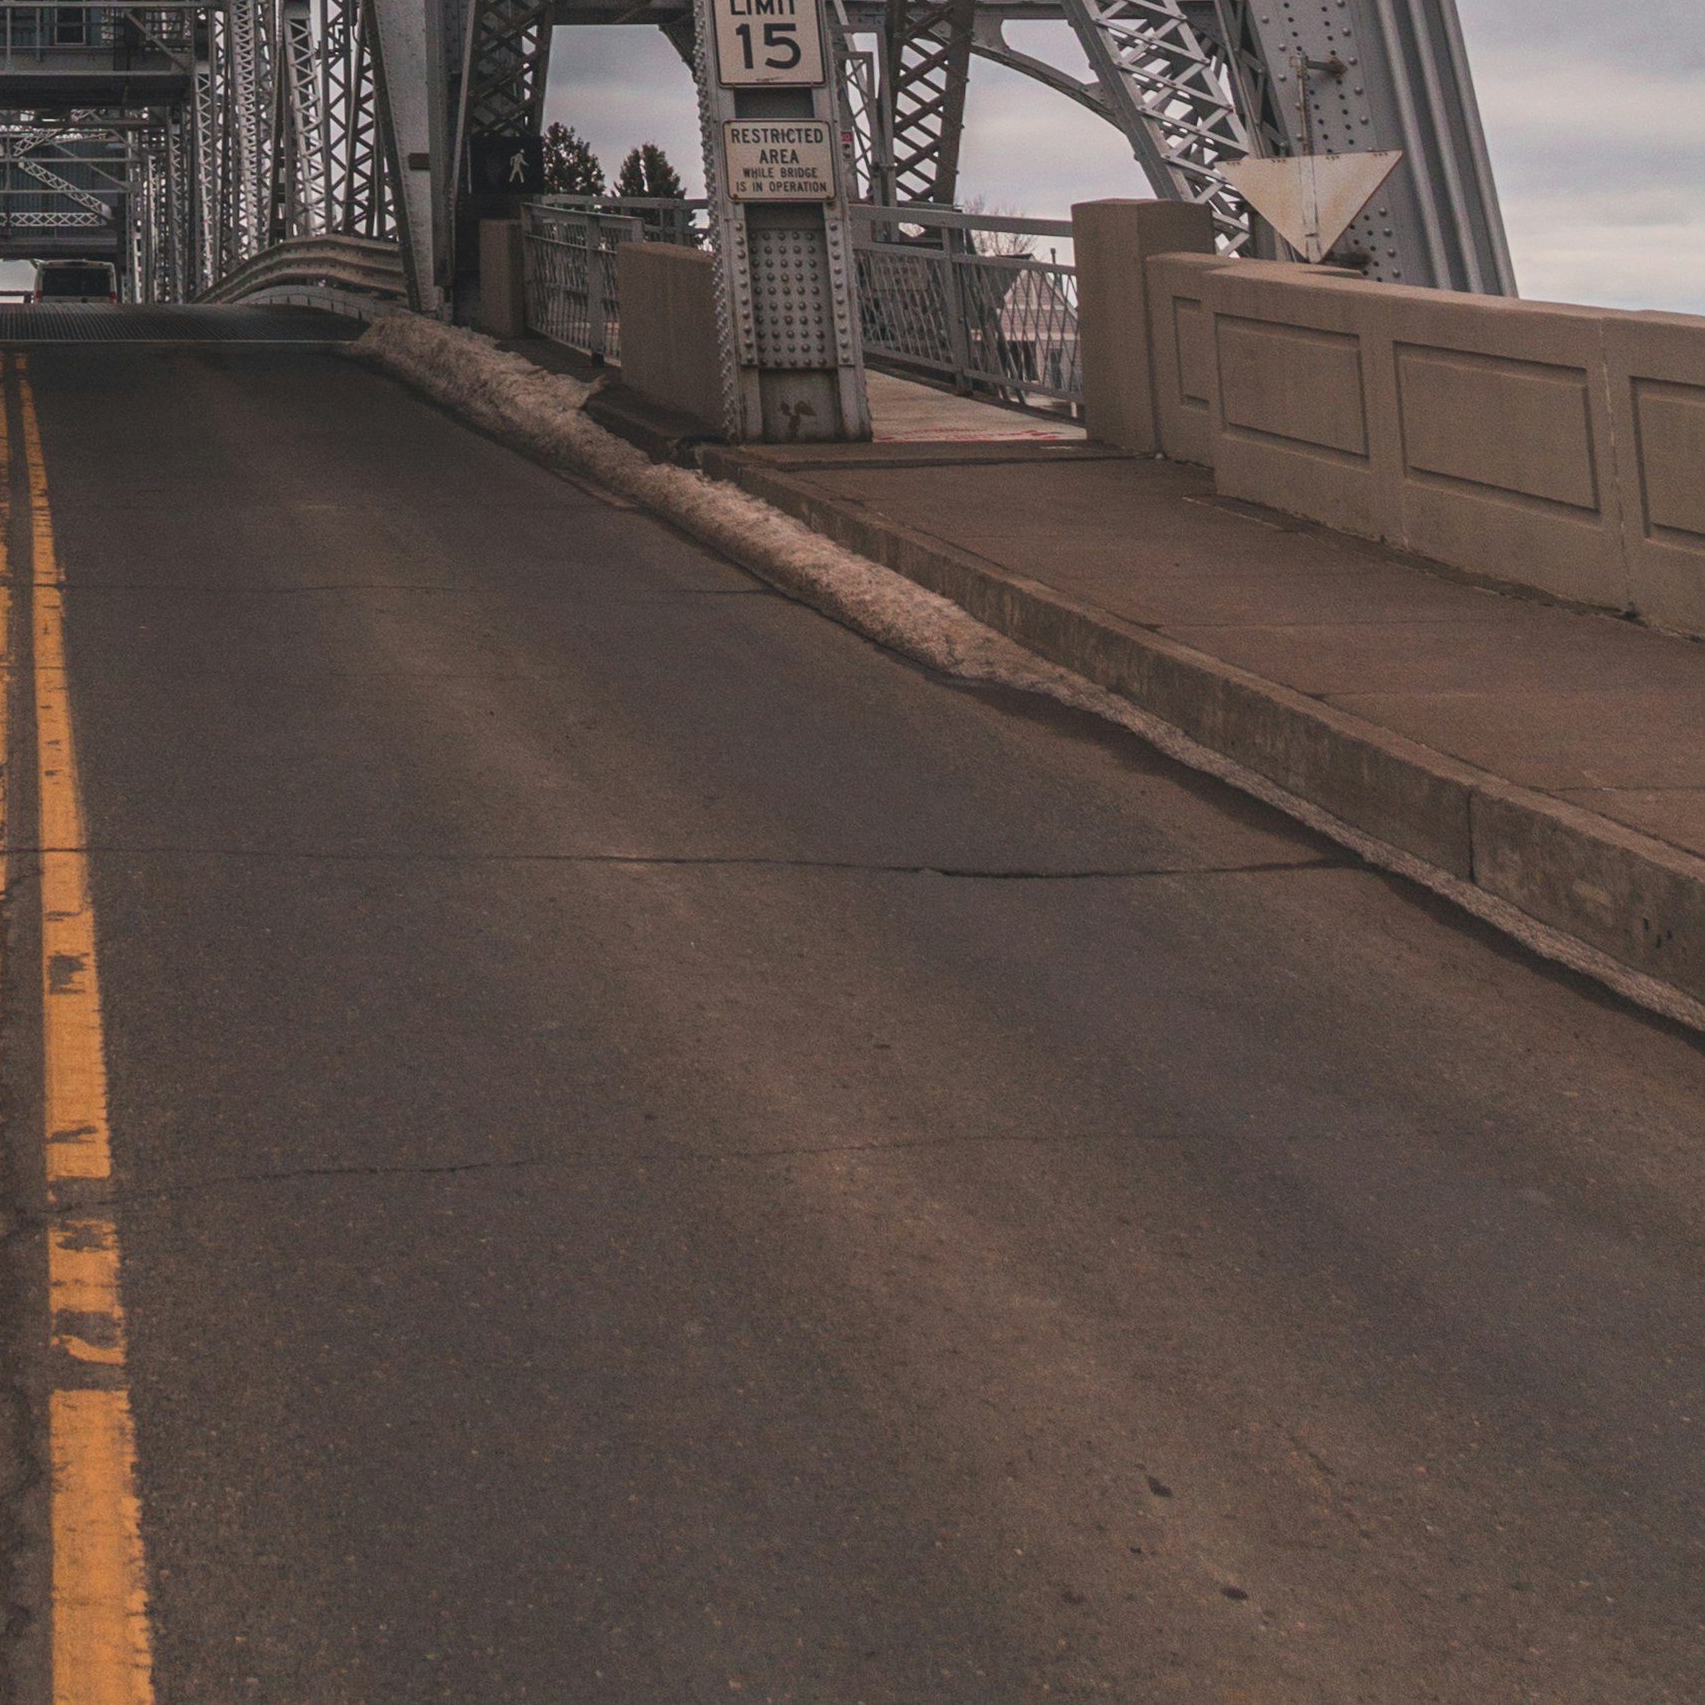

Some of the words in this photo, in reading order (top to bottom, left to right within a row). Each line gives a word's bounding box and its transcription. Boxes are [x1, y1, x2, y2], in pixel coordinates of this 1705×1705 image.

[735, 22, 802, 70] 15
[731, 128, 824, 143] RESTRICTED
[759, 149, 799, 164] AREA
[742, 167, 774, 178] WHILE
[780, 167, 818, 178] BRIDGE
[736, 181, 746, 192] IS
[752, 181, 763, 192] IN
[769, 181, 827, 192] OPERATION
